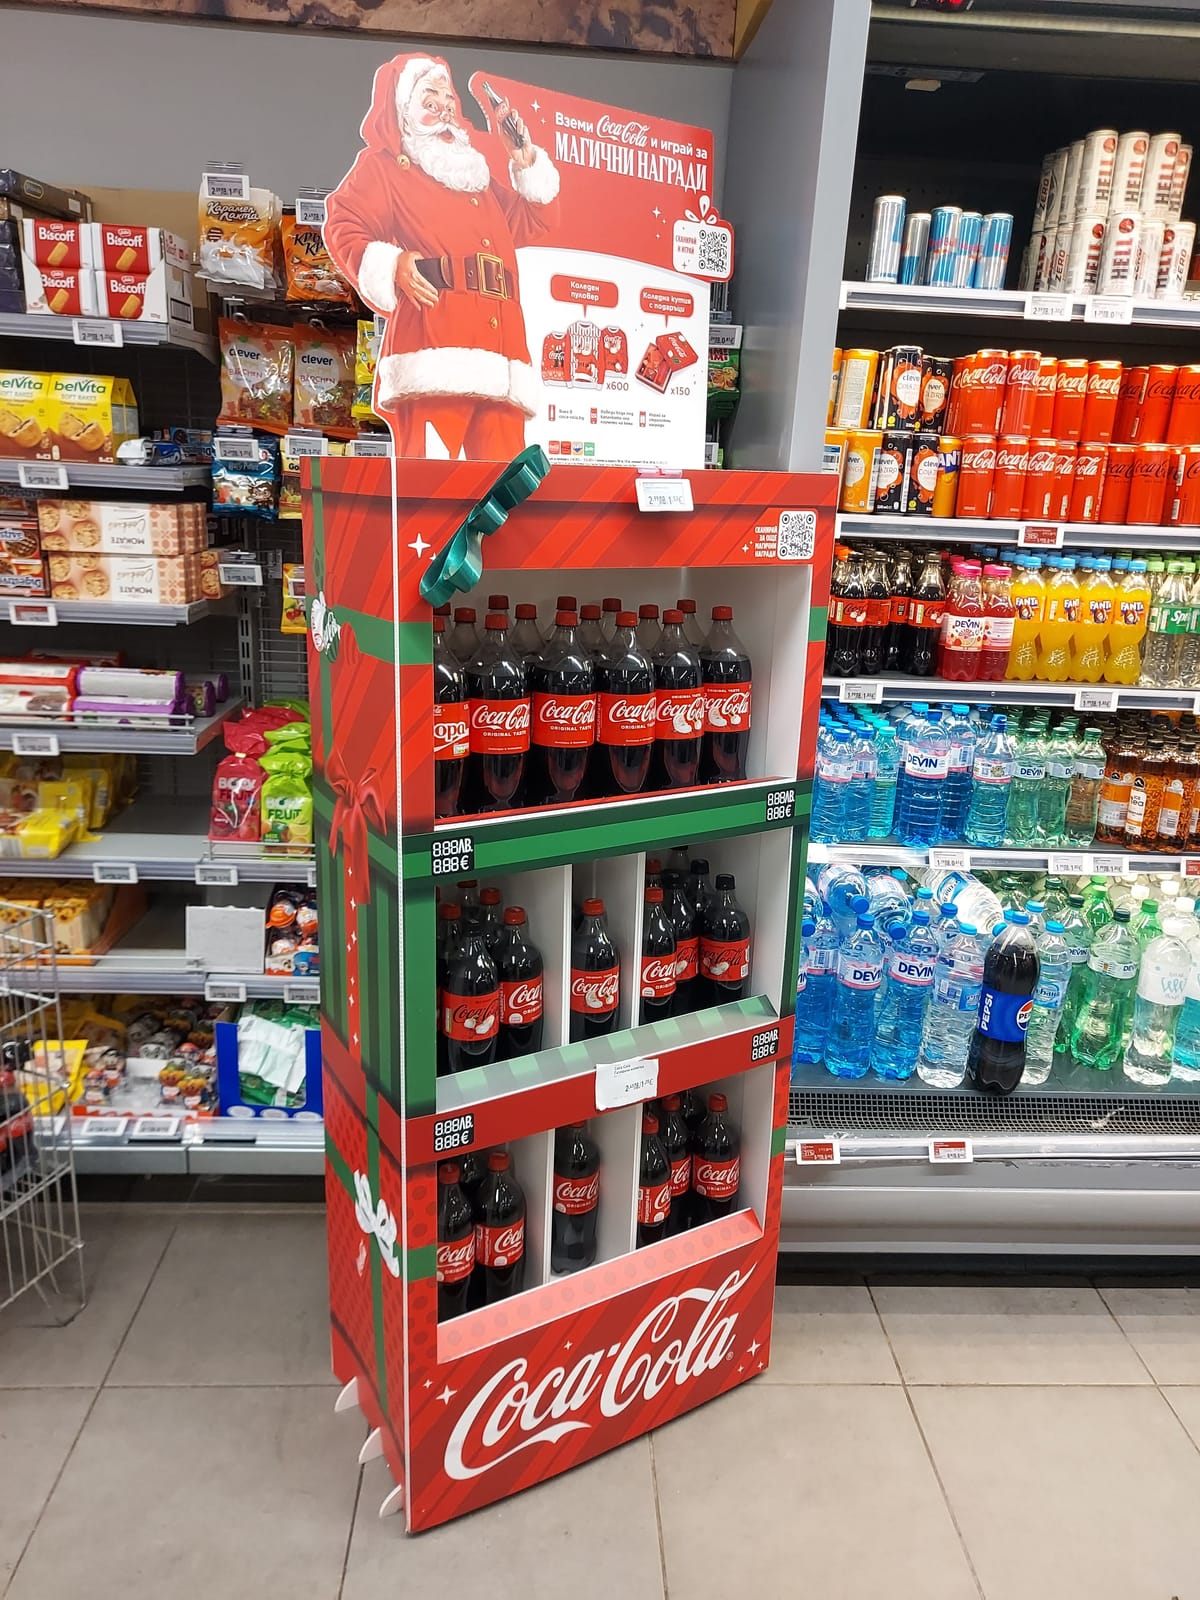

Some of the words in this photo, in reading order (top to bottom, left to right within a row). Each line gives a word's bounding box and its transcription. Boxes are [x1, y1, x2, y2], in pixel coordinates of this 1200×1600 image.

[555, 112, 593, 133] Вземи
[596, 114, 650, 147] Coca-Cola
[651, 138, 657, 147] и
[660, 140, 693, 156] играй
[696, 148, 708, 160] за
[555, 132, 634, 177] МАГИЧНИ
[638, 150, 707, 194] НАГРАДИ
[1096, 160, 1113, 200] HELL
[1125, 161, 1144, 202] HELL
[1155, 164, 1175, 204] HELL
[208, 202, 255, 215] Карамел
[220, 210, 259, 222] Лакта
[38, 227, 76, 242] Biscoff
[106, 232, 142, 248] Biscoff
[1055, 250, 1066, 282] ZERO
[1085, 244, 1102, 284] HELL
[1111, 238, 1134, 280] HELL
[1176, 249, 1187, 282] ZERO
[570, 281, 600, 292] Коледен
[570, 291, 599, 301] пуловер
[643, 292, 669, 302] Коледна
[229, 348, 261, 360] clever
[302, 354, 333, 366] clever
[0, 377, 43, 390] elVita
[54, 380, 106, 394] belVita
[606, 381, 629, 392] x600
[671, 387, 690, 396] x150
[938, 450, 960, 468] ANT
[755, 526, 777, 534] СКАНИРАЙ
[755, 550, 776, 558] НАГРАДИ
[955, 619, 979, 629] DEVIN
[609, 697, 656, 722] Coca-Co
[908, 753, 938, 768] DEVIN
[1020, 768, 1043, 776] DEVIN
[268, 809, 302, 820] FRUIT
[898, 961, 934, 977] DEVIN
[981, 994, 993, 1031] PEPSI
[444, 1262, 757, 1480] Coca-Cola
